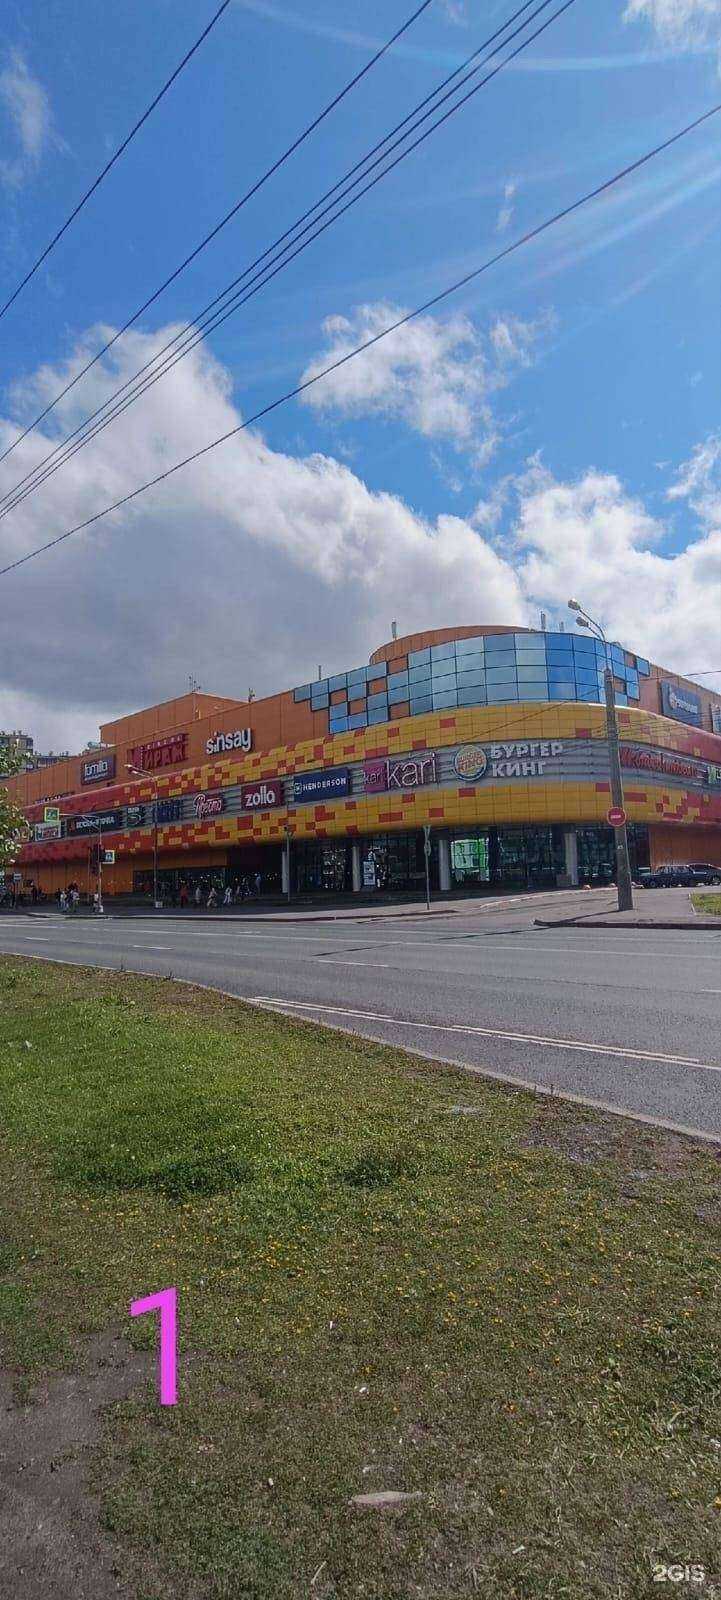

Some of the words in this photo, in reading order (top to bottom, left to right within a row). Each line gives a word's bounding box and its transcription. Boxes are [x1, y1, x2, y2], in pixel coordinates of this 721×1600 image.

[206, 728, 252, 755] sinsay
[490, 742, 563, 759] БУРГЕР
[386, 752, 437, 788] kari
[493, 760, 546, 777] КИНГ
[302, 777, 346, 792] HENDERSON
[245, 785, 275, 807] zolla
